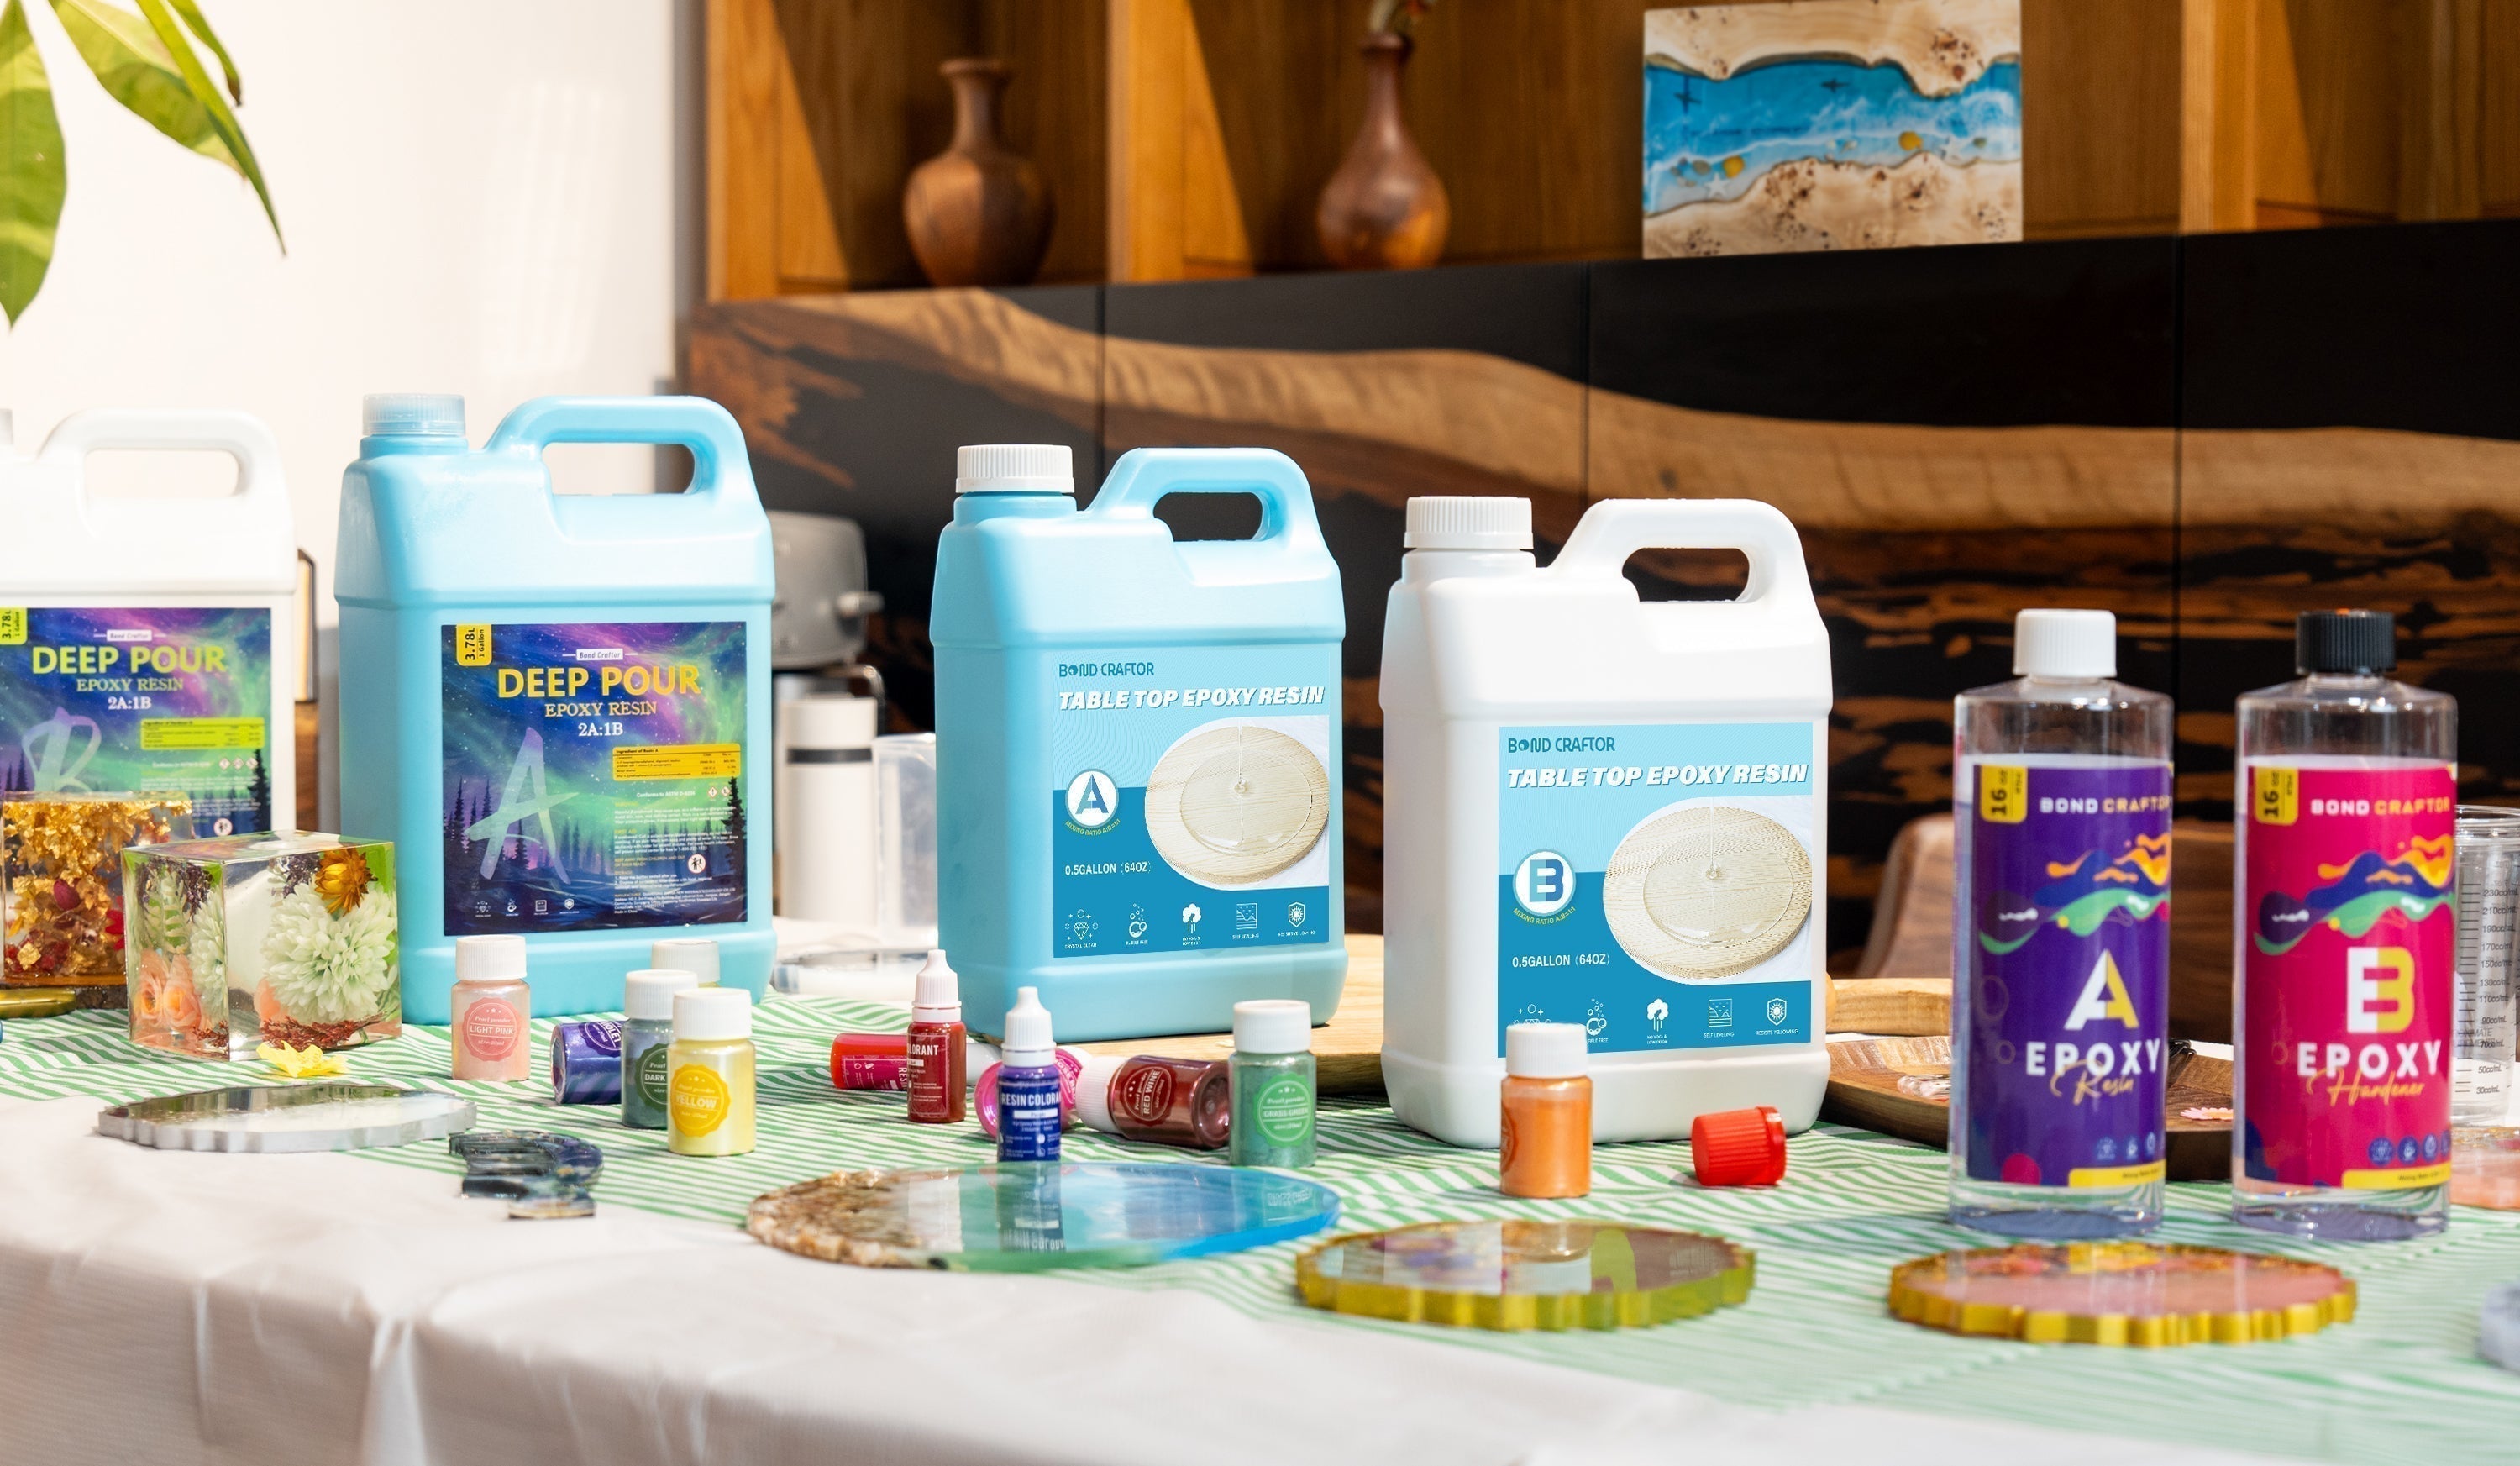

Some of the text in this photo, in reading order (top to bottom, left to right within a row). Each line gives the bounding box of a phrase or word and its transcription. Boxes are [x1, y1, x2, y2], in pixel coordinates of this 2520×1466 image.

[465, 628, 475, 661] 3.78L
[32, 645, 227, 674] DEEP POUR
[1058, 662, 1154, 677] BOND CRAFTOR
[76, 678, 183, 691] EPOXY RESIN
[498, 665, 701, 698] DEEP POUR
[108, 696, 152, 710] 2A:1B
[1058, 686, 1325, 711] TABLE TOP EPOXY RESIN
[544, 701, 658, 717] EPOXY RESIN
[577, 722, 624, 737] 2A:1B
[1508, 736, 1615, 754] BOND CRAFTOR
[1507, 763, 1809, 789] TABLE TOP EPOXY RESIN
[1075, 774, 1109, 815] A
[1992, 788, 2007, 816] 16
[465, 727, 580, 885] A
[2039, 796, 2099, 814] BOND
[2263, 791, 2279, 817] 16
[2310, 796, 2450, 816] BOND CRAFTOR
[1064, 820, 1084, 835] MIXING
[1064, 863, 1116, 875] 0.5GALLON
[1529, 859, 1564, 902] B
[2483, 889, 2518, 897] 230cc/mL
[1513, 906, 1576, 925] MIXING RATIO A:B=1:1
[1512, 954, 1571, 968] 0.5GALLON
[2063, 948, 2140, 1030] A
[2347, 946, 2415, 1033] B
[2481, 1015, 2507, 1024] 90cc/mL
[470, 1025, 513, 1035] LIGHT PINK
[2025, 1038, 2161, 1077] EPOXY
[2297, 1039, 2442, 1079] EPOXY
[644, 1073, 666, 1082] DARK
[2478, 1064, 2502, 1074] 50cc/mL
[1145, 1070, 1161, 1093] WINE
[2050, 1059, 2134, 1106] Resin
[2476, 1085, 2500, 1094] 30cc/mL
[675, 1093, 717, 1109] YELLOW
[1001, 1092, 1026, 1106] RESIN
